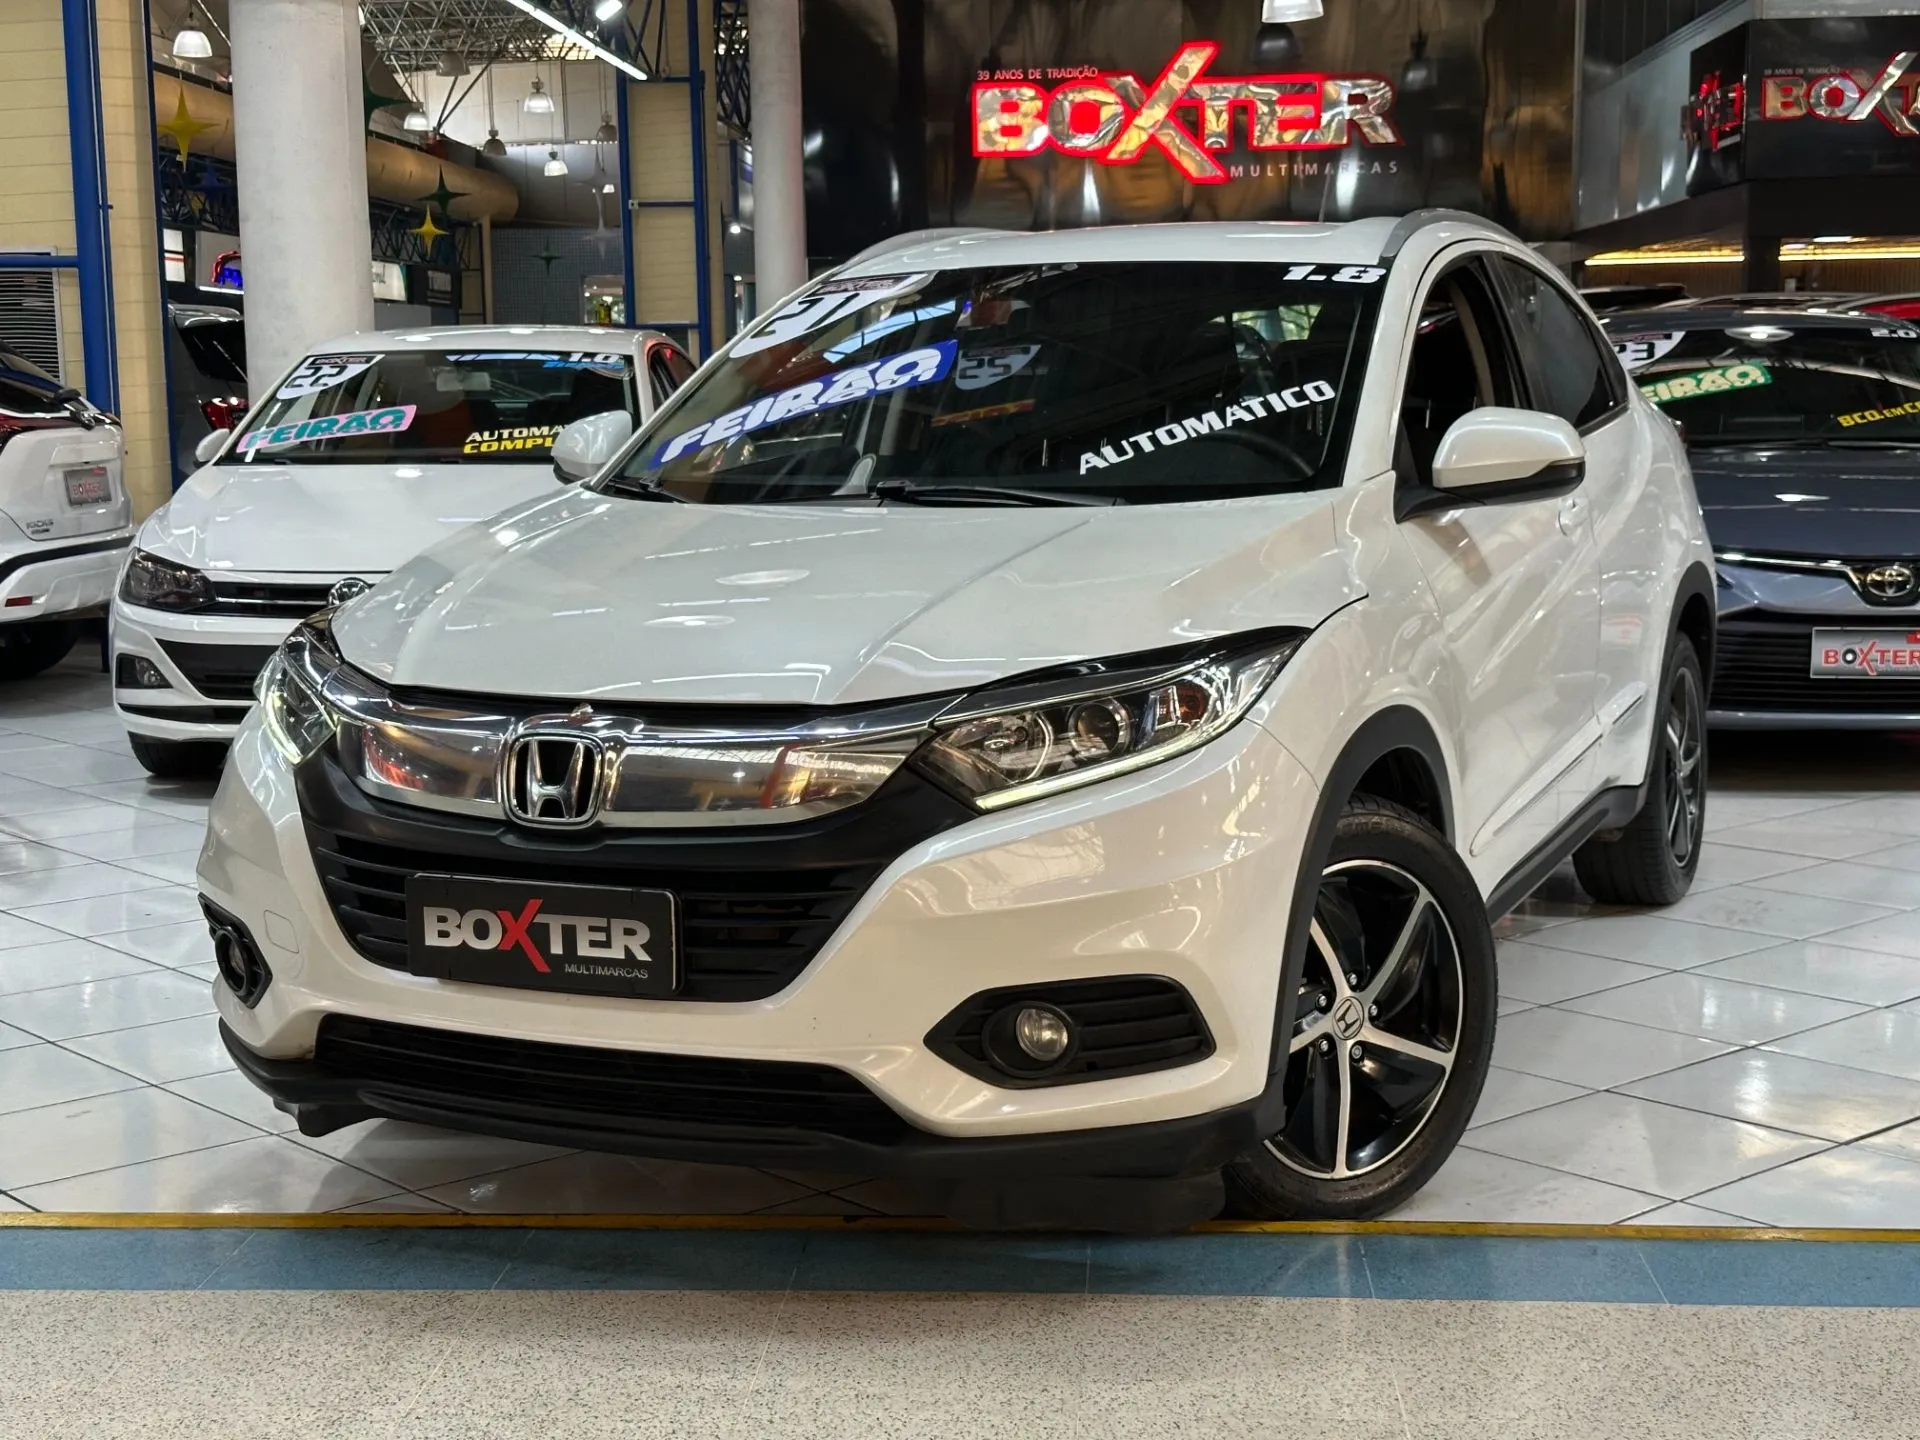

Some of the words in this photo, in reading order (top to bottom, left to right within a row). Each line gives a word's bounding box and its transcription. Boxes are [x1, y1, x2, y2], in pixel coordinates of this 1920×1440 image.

[976, 70, 990, 81] 39
[994, 68, 1024, 80] ANOS
[1028, 67, 1042, 79] DE
[1047, 64, 1099, 79] TRADIÇÃO
[972, 41, 1403, 184] BOXTER
[1230, 160, 1399, 178] MULTIMARCAS
[1283, 265, 1387, 284] 1.8
[1870, 327, 1918, 338] 2.0
[568, 352, 620, 364] 1.0
[284, 365, 348, 388] 22
[660, 348, 942, 464] FEIRÃO
[423, 899, 653, 973] BOXTER
[565, 962, 648, 979] MULTIMARCAS
